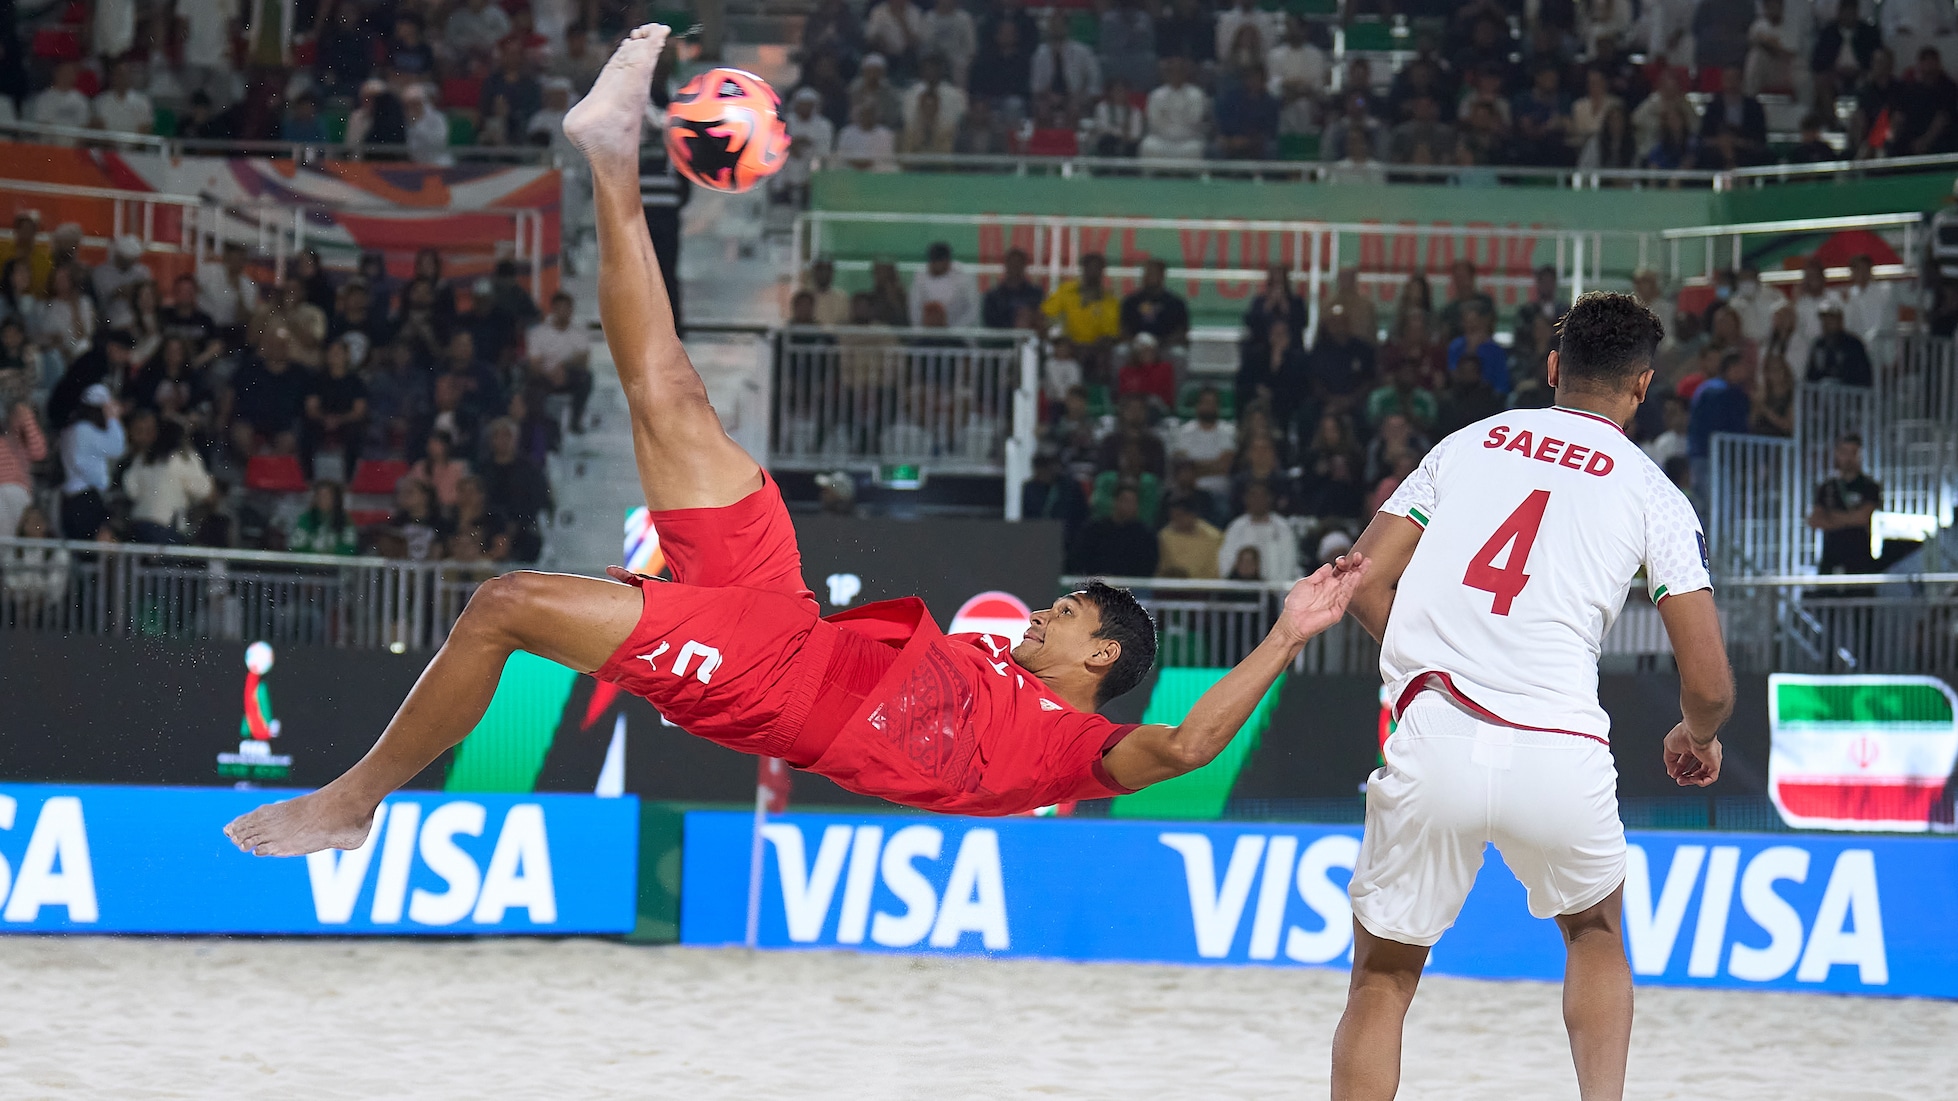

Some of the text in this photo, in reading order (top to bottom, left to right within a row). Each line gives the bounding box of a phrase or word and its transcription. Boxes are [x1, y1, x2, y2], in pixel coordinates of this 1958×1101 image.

[1359, 218, 1542, 303] MARK
[1483, 425, 1615, 477] SAEED
[1462, 489, 1551, 616] 4
[759, 823, 1010, 949] VISA
[1158, 832, 1362, 964] VIS
[1624, 843, 1889, 985] VISA
